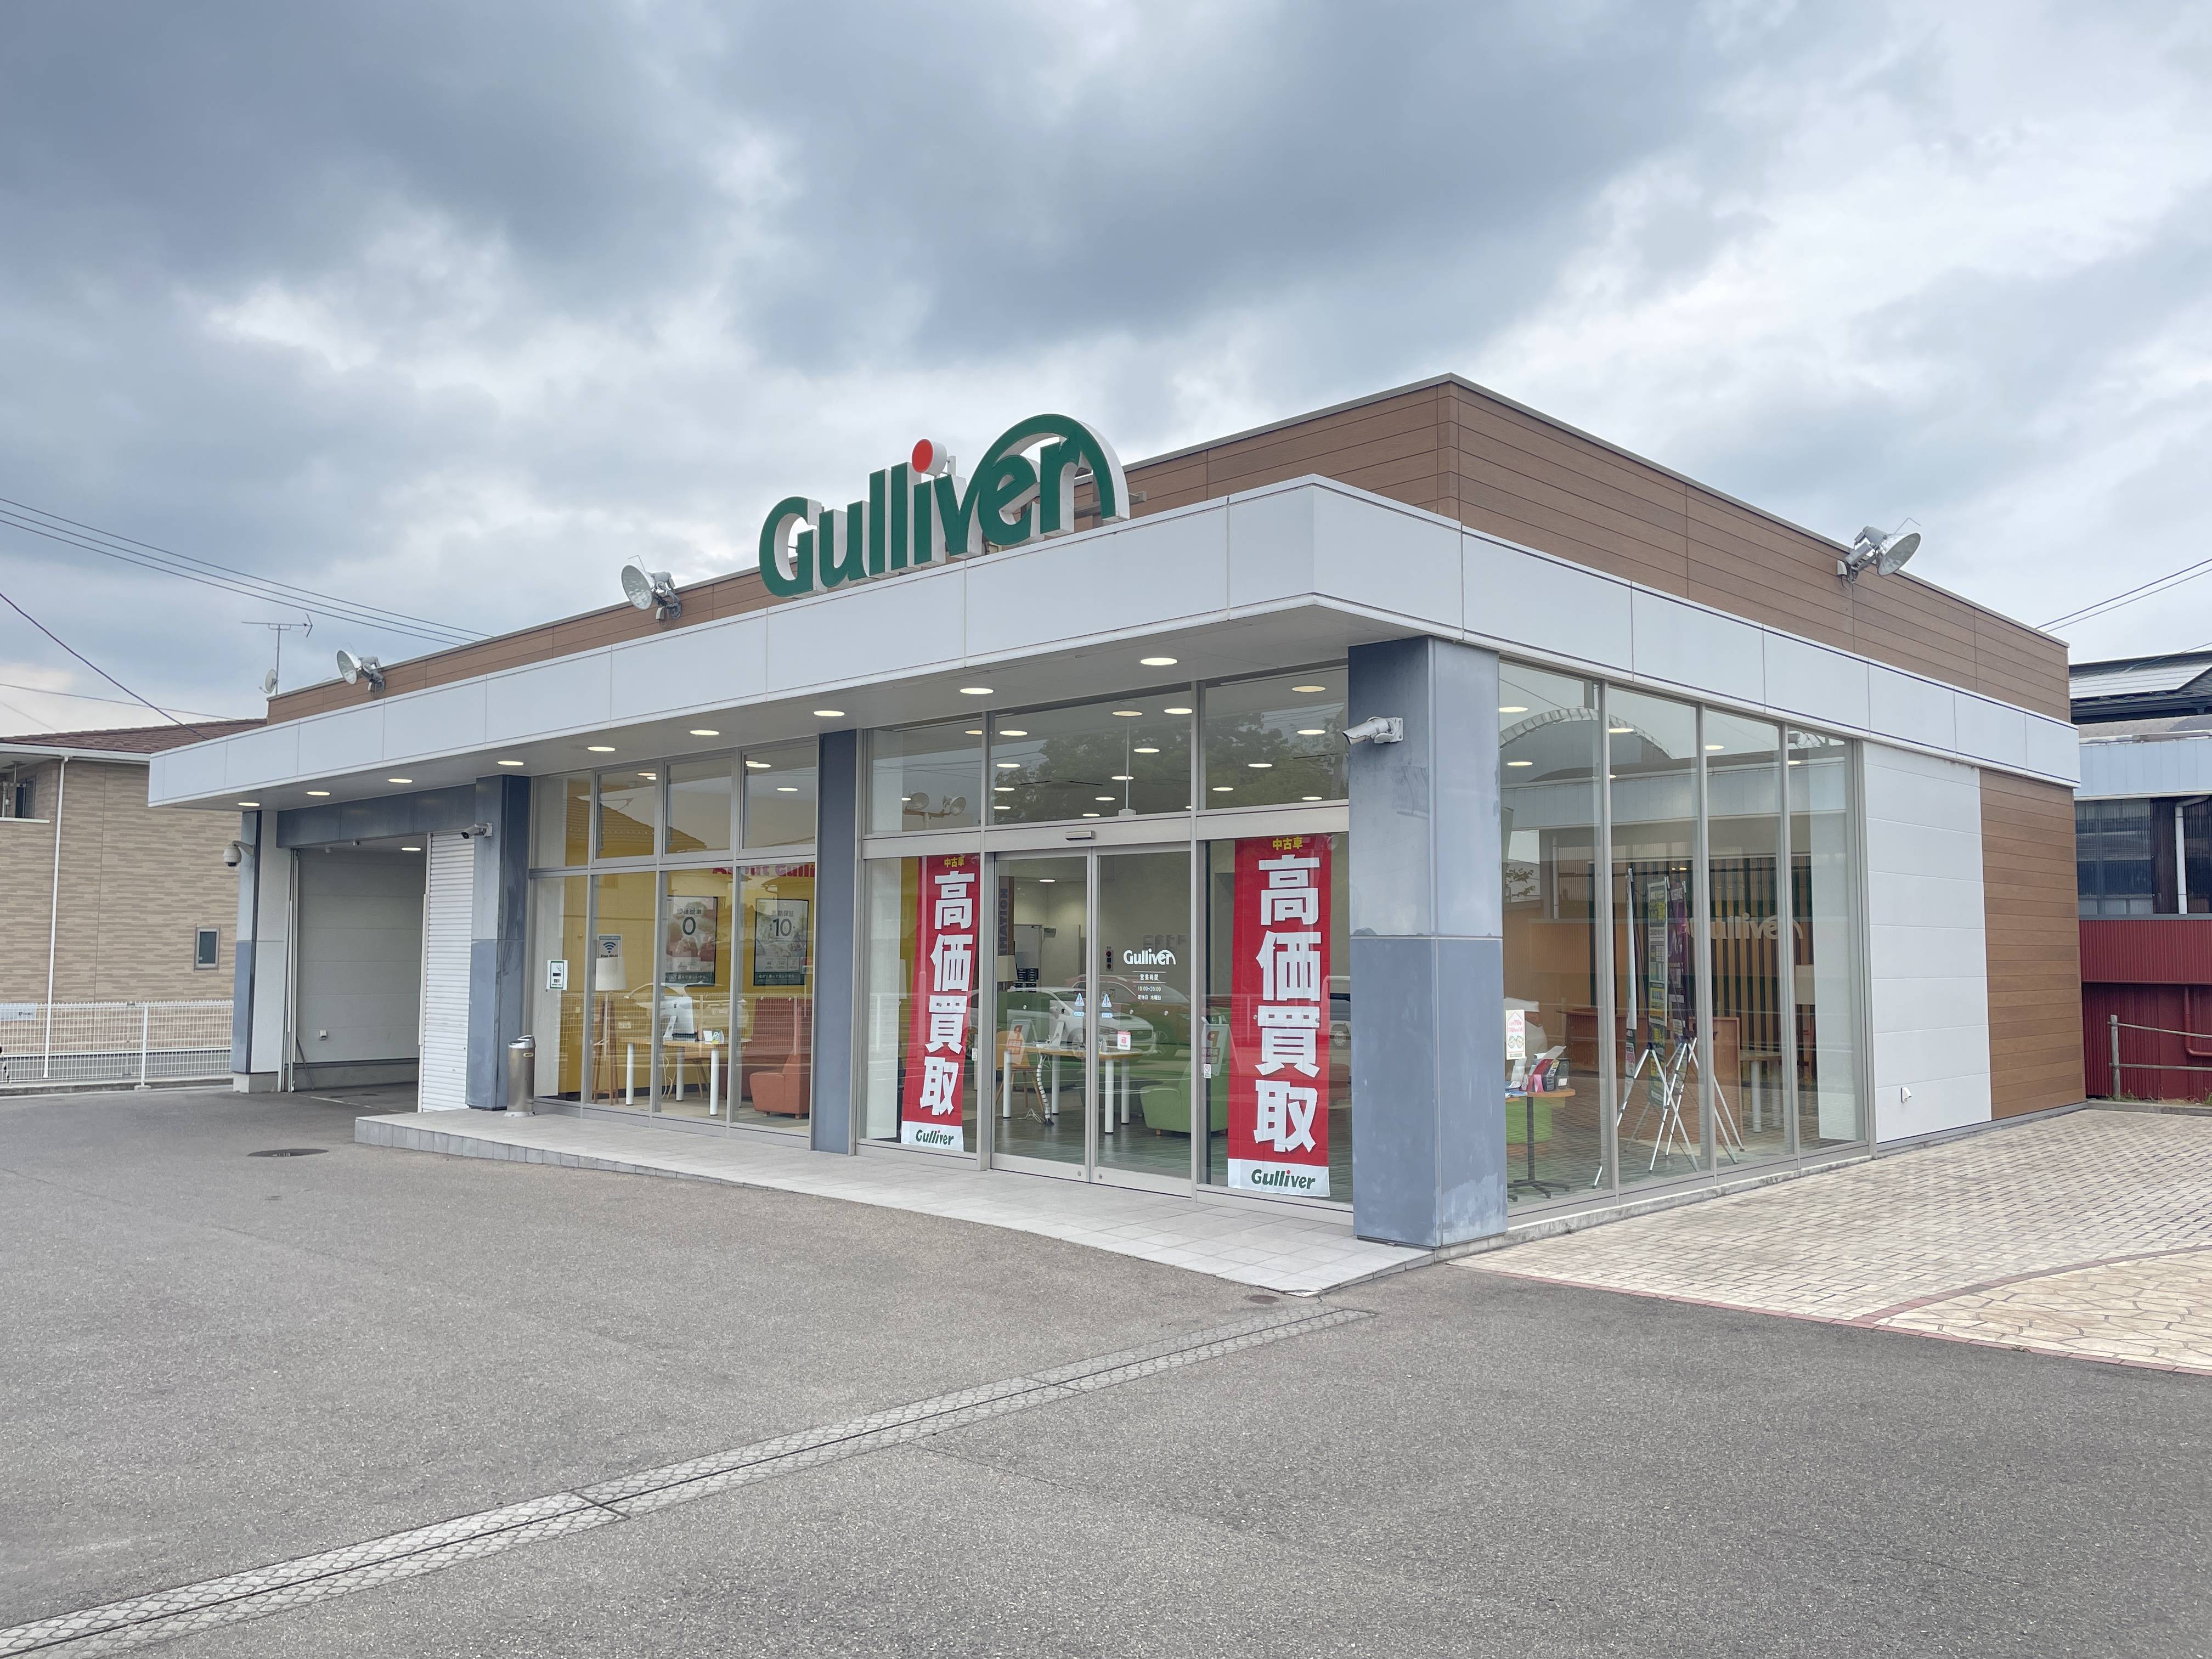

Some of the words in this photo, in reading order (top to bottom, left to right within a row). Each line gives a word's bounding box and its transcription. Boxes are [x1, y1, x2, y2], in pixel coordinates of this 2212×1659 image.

[759, 414, 1128, 598] Gulliver
[1272, 836, 1303, 850] 中古車
[944, 856, 965, 868] 中古車
[1123, 948, 1176, 965] Gulliver
[919, 870, 975, 1116] 高価買取
[1254, 854, 1322, 1153] 高価買取
[916, 1128, 955, 1146] Gulliver
[1251, 1169, 1316, 1190] Gulliver
